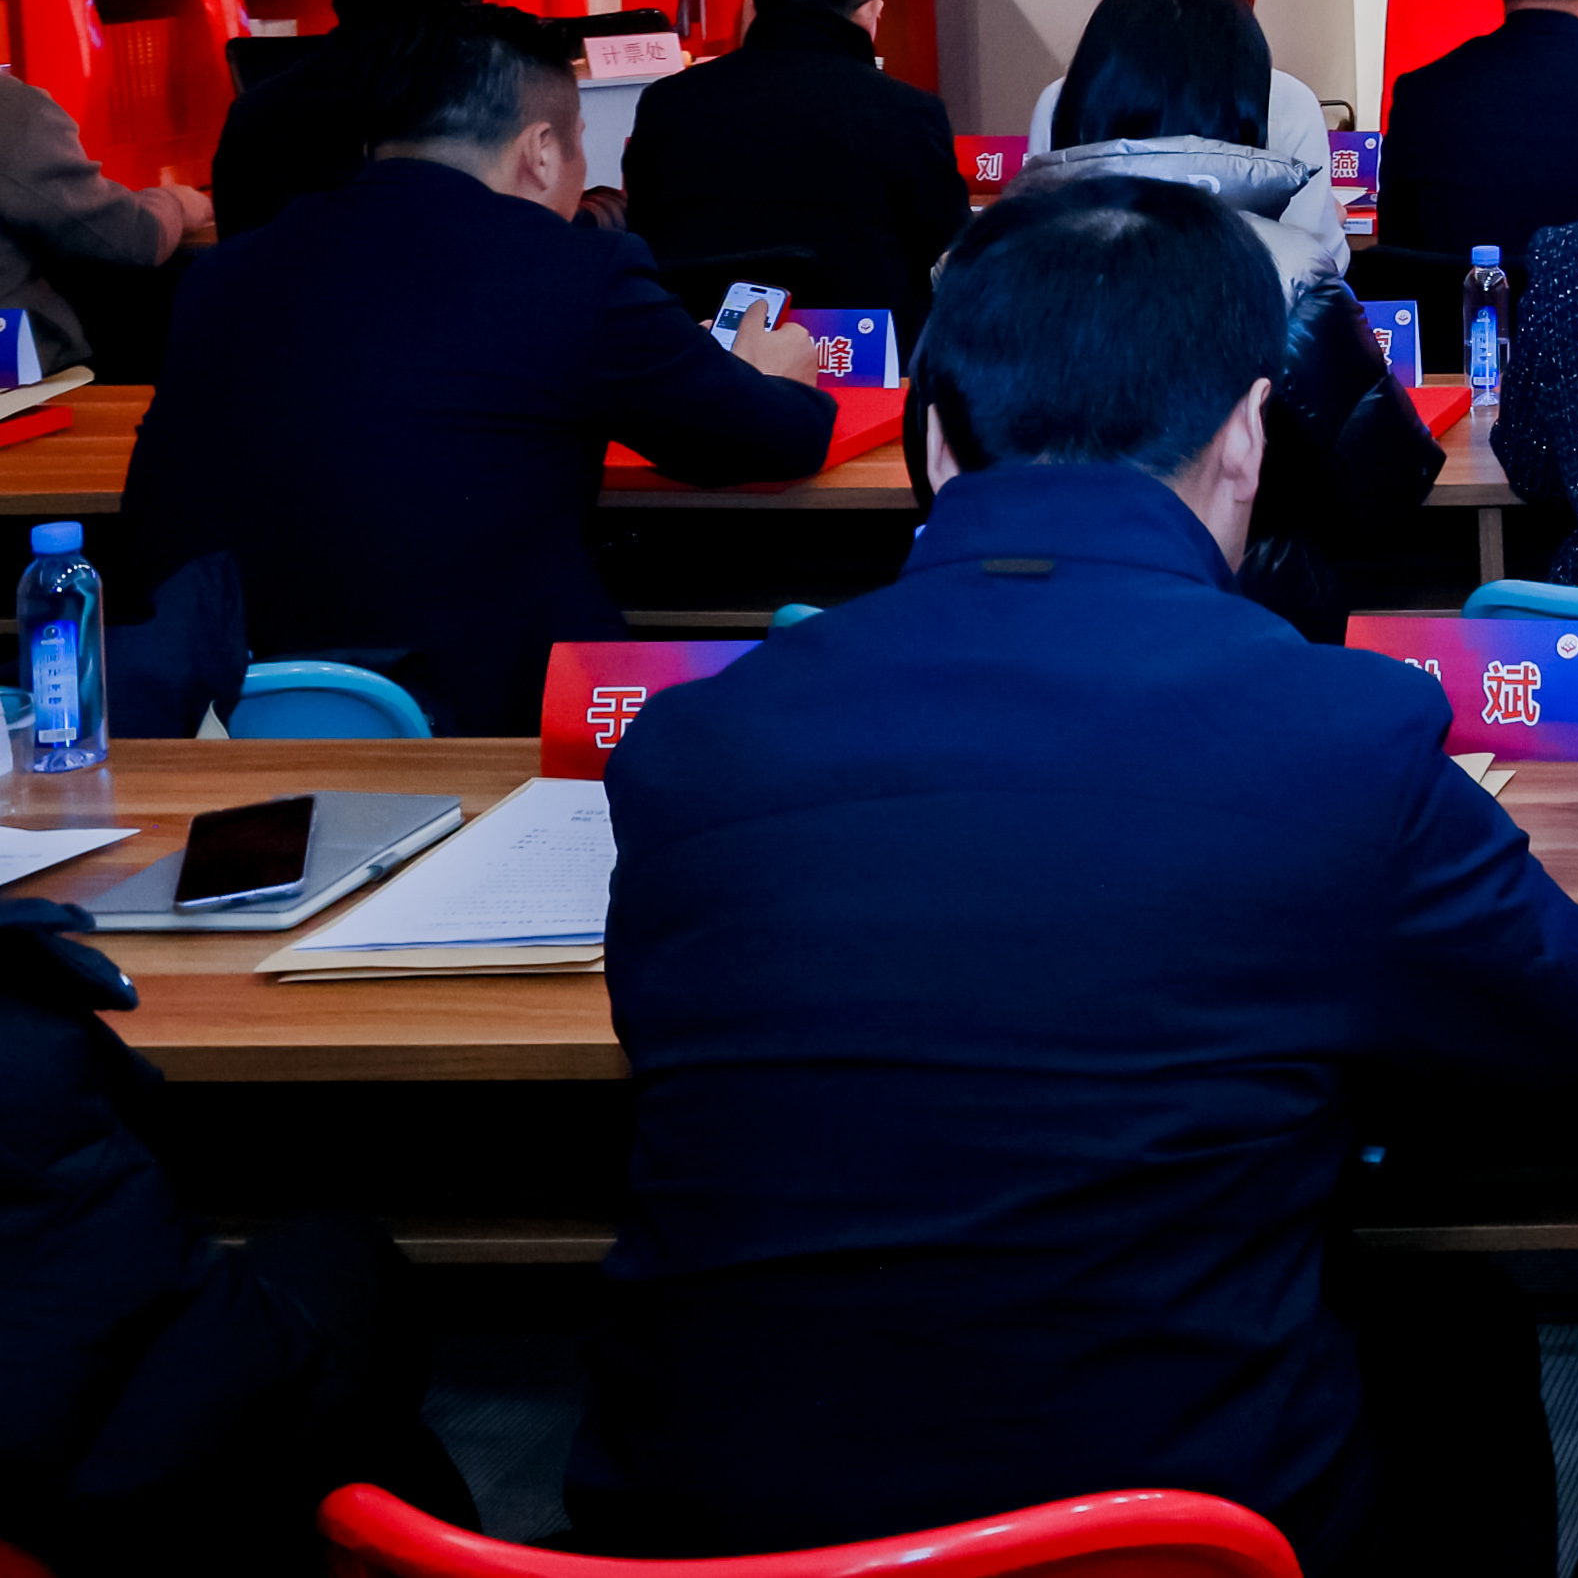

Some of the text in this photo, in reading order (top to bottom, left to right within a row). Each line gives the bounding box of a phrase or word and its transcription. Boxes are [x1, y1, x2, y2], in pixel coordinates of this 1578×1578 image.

[602, 41, 667, 65] 计票处
[1332, 149, 1359, 179] 燕
[809, 335, 854, 378] 峰
[586, 686, 647, 749] 于
